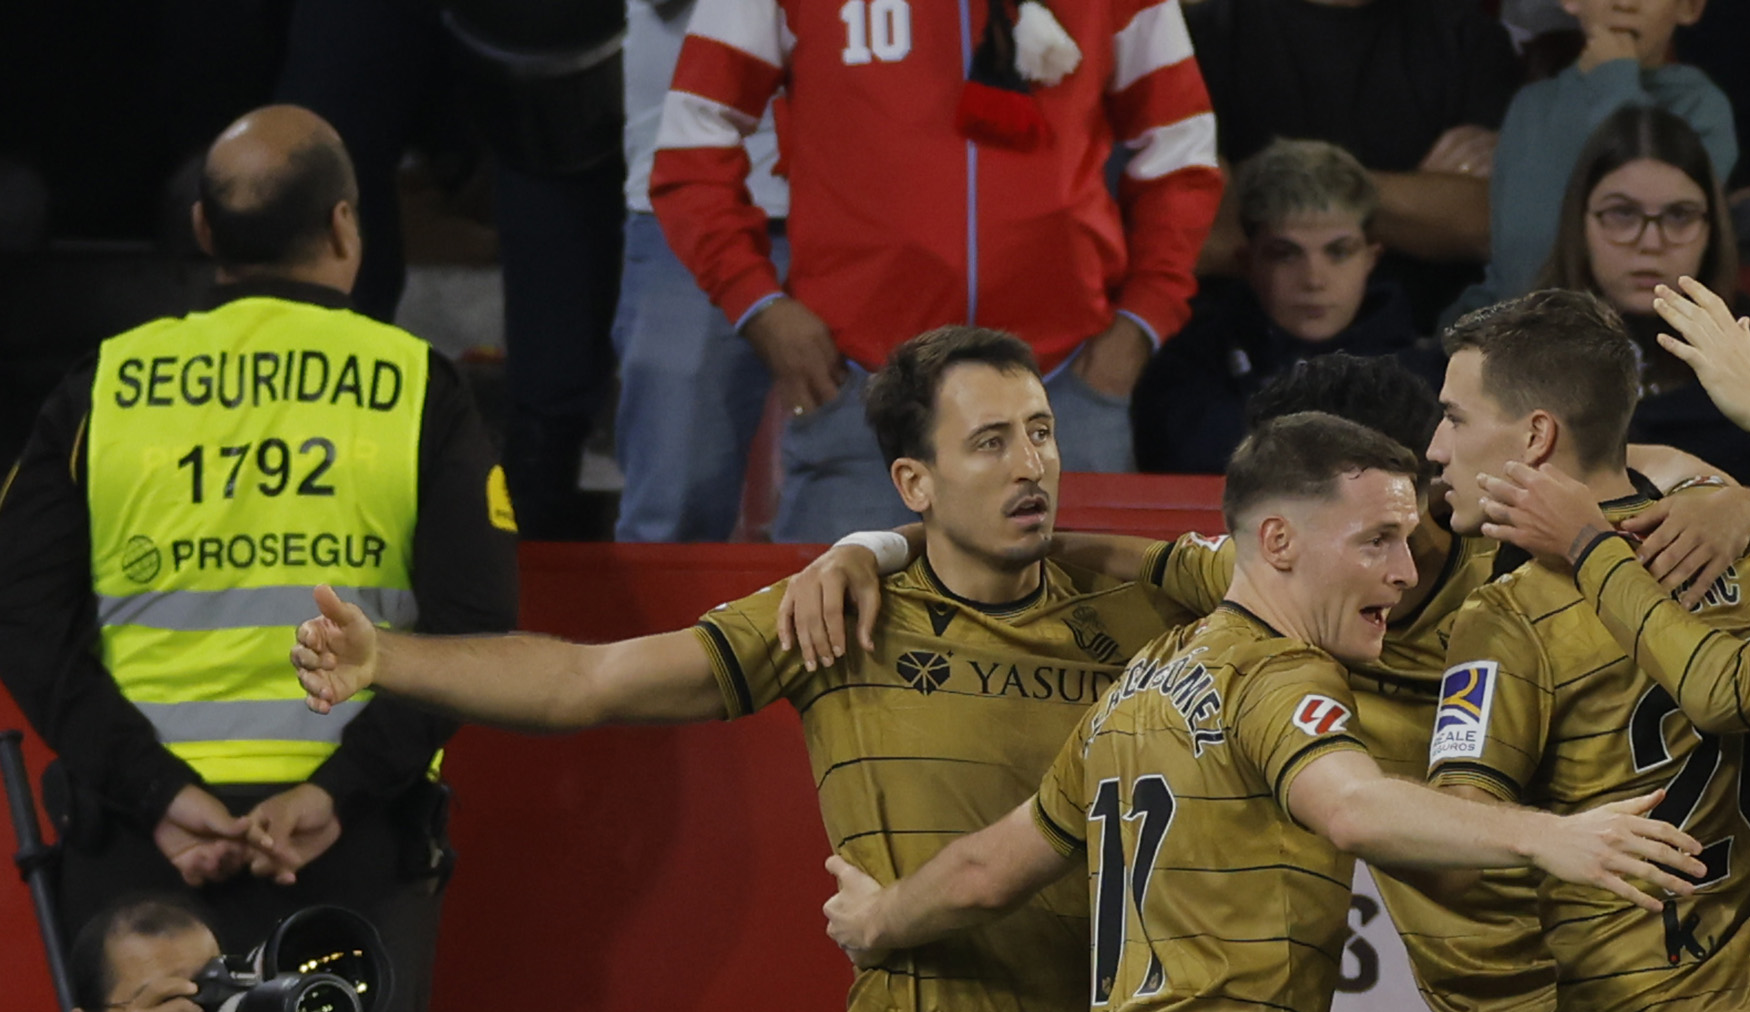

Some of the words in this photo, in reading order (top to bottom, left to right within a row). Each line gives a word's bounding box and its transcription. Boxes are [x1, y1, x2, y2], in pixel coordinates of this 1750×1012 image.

[838, 0, 912, 65] 10
[114, 350, 404, 411] SEGURIDAD
[177, 436, 336, 503] 1792
[172, 532, 386, 571] PROSEGUR
[968, 660, 1117, 703] YASUD
